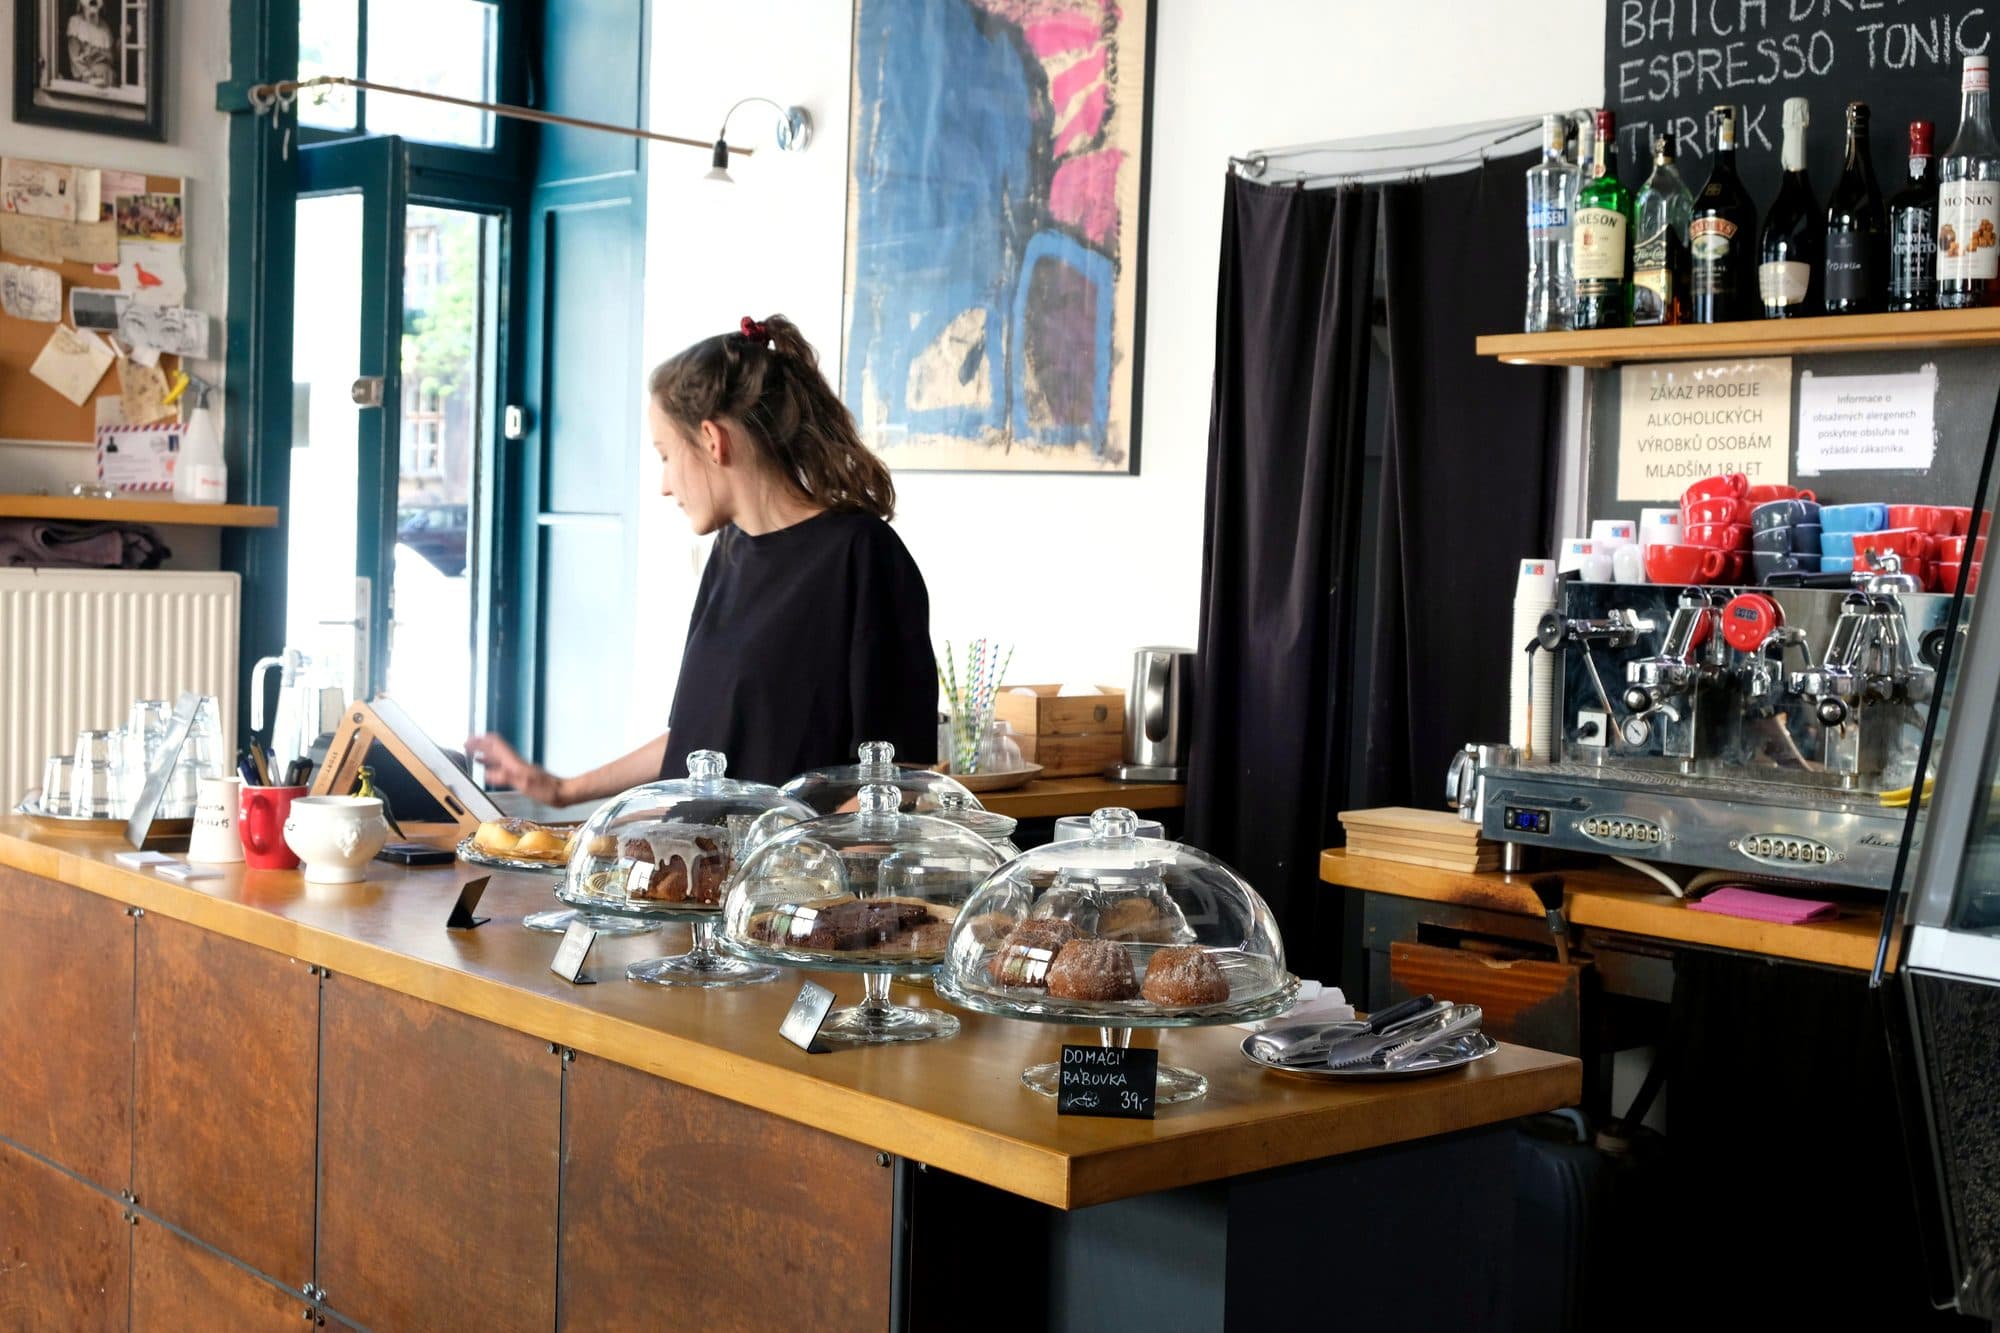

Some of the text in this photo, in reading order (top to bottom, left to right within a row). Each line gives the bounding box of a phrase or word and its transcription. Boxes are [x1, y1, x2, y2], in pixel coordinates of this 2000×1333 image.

[1619, 8, 1991, 103] ESPRESSO TONIC
[1944, 195, 1993, 207] MONIN
[1650, 382, 1760, 401] ZÁKAZ PRODEJE
[1647, 406, 1763, 427] ALKOHOLICKÝCH
[1638, 432, 1772, 453] VÝROBKŮ OSOBÁM
[1645, 460, 1712, 478] MLADŠÍM
[1718, 462, 1734, 476] 18
